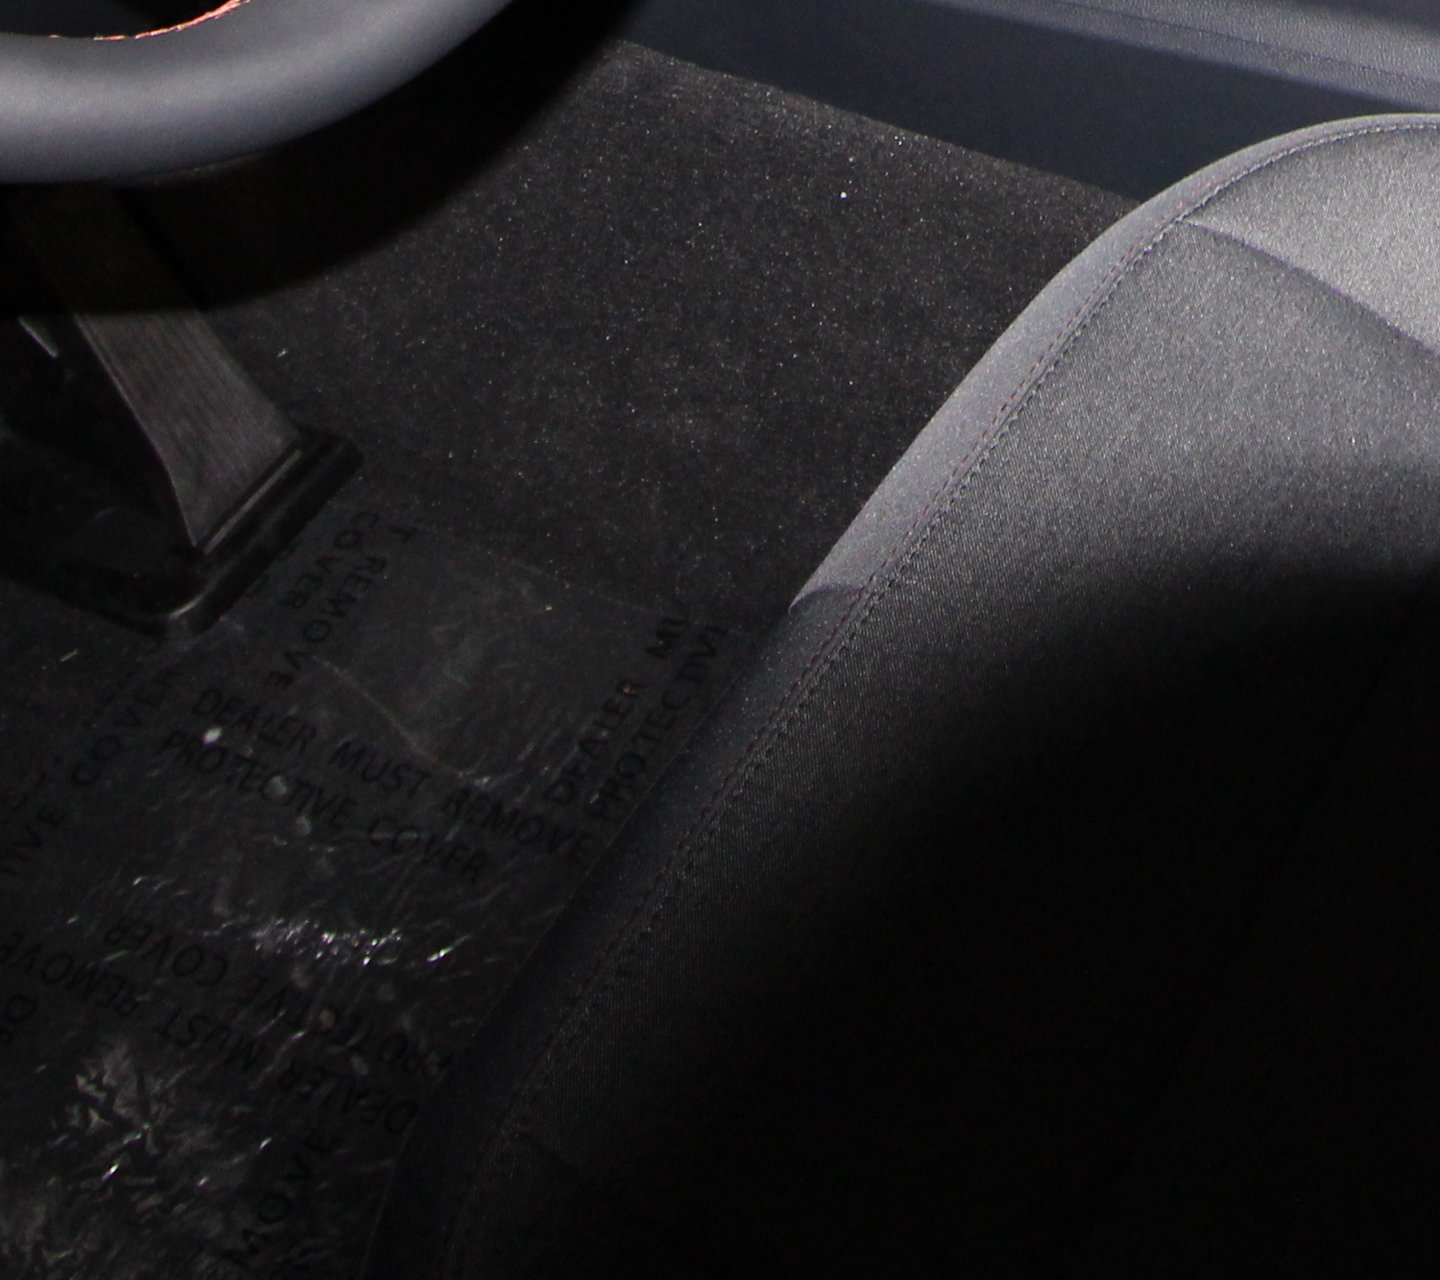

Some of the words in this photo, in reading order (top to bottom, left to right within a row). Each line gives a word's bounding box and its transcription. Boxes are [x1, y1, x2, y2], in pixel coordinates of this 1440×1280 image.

[267, 554, 388, 691] REMOVE
[191, 686, 318, 756] DEALER
[327, 740, 432, 800] MUST
